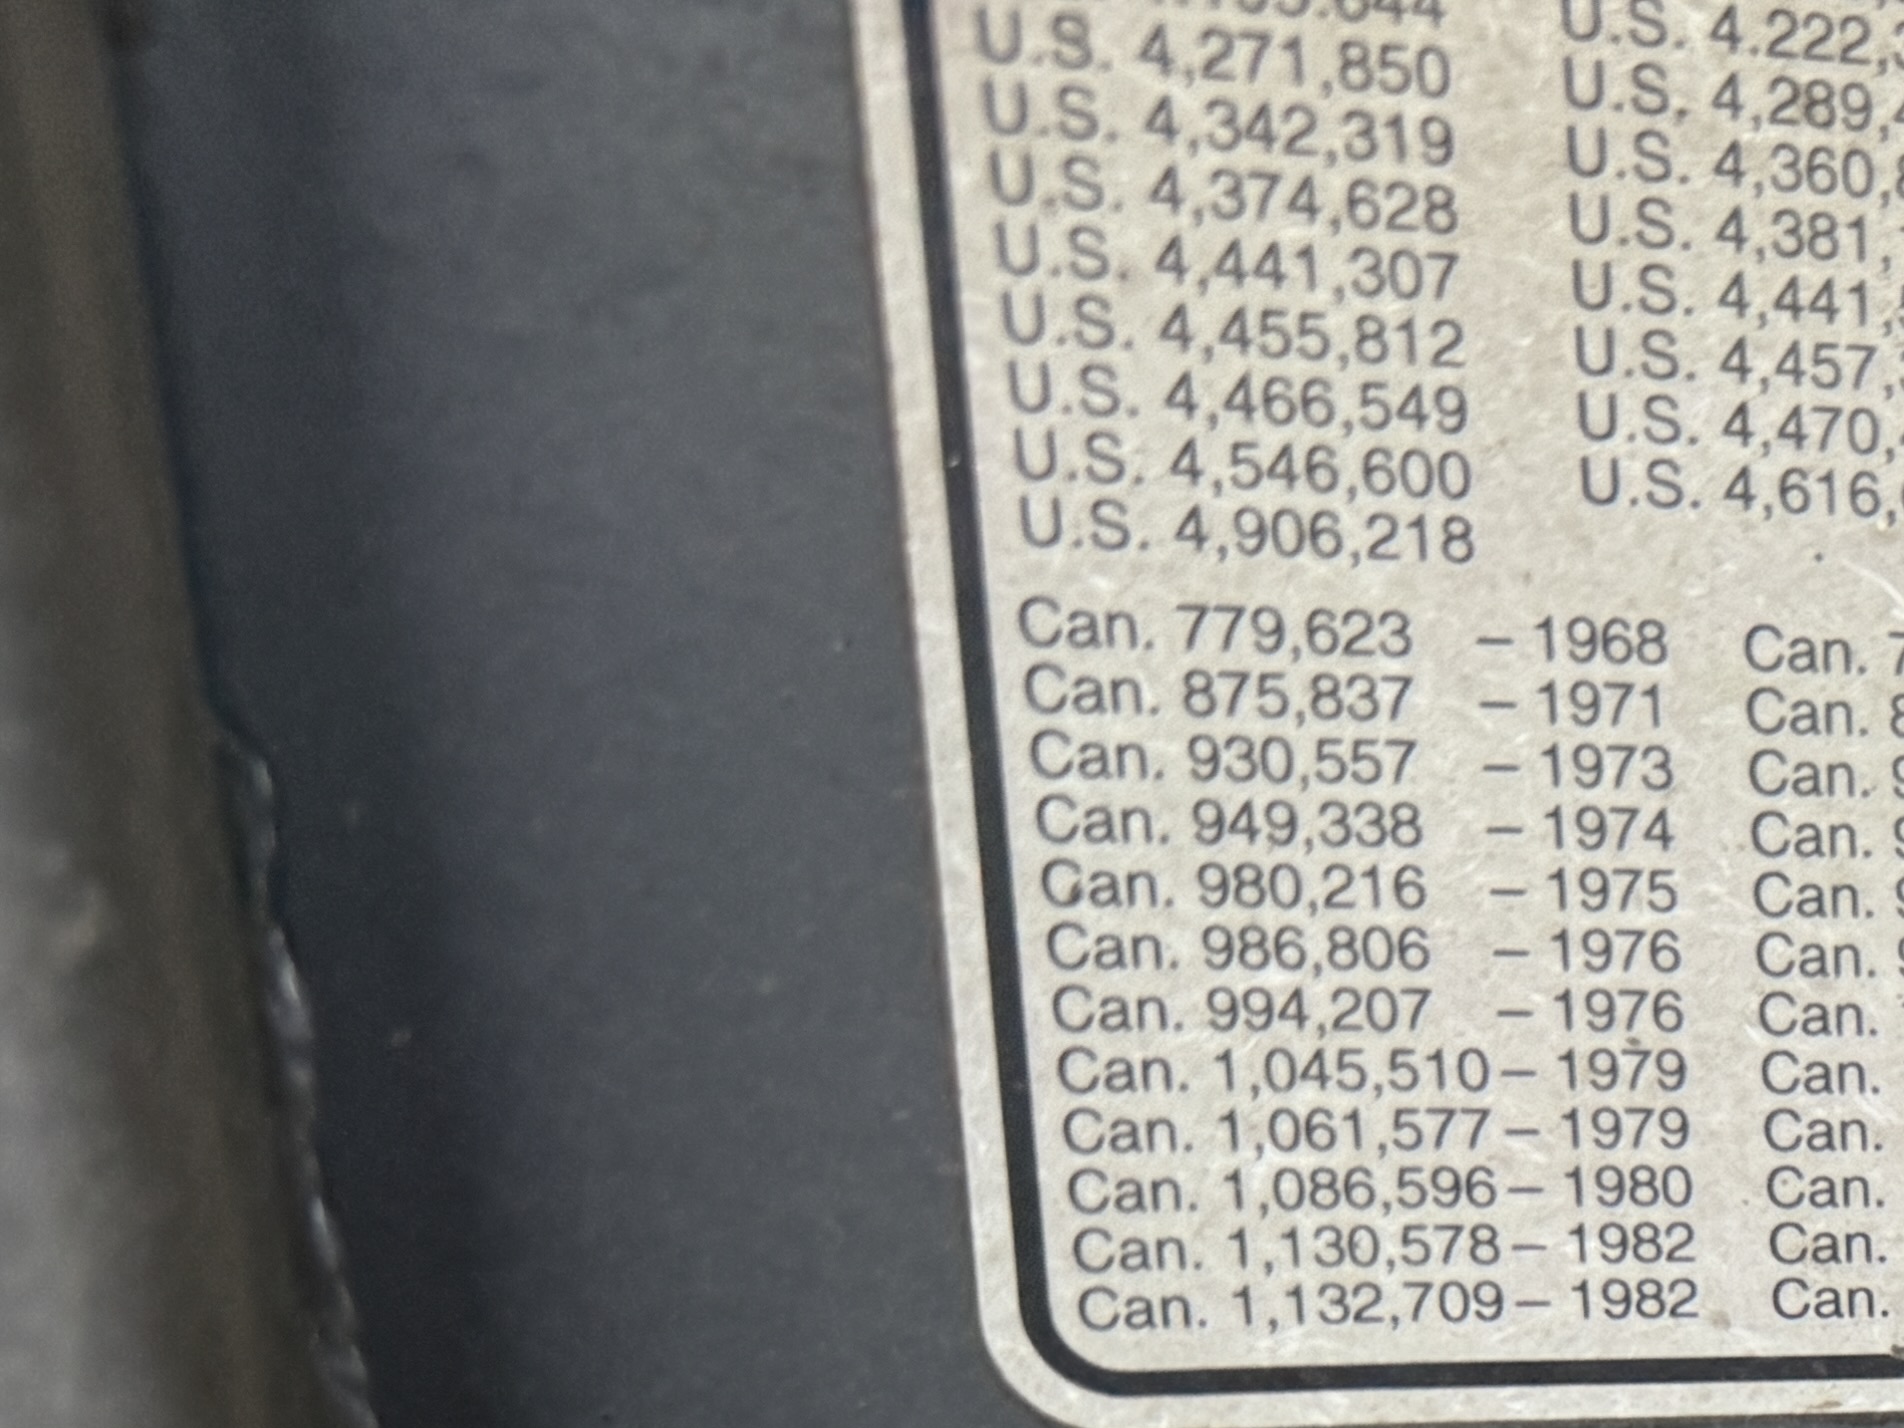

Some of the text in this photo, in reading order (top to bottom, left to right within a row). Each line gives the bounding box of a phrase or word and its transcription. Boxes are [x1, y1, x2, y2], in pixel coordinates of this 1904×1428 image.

[1560, 0, 1685, 48] U.S.
[976, 9, 1111, 69] U.S.
[1138, 24, 1450, 98] 4,271,850
[1563, 56, 1688, 122] U.S.
[982, 80, 1454, 166] U.S. 4,342,319
[1566, 125, 1689, 184] U.S.
[988, 150, 1457, 235] U.S. 4,374,628
[1569, 192, 1690, 250] U.S.
[994, 222, 1459, 303] U.S. 4,441,307
[1572, 259, 1693, 315] U.S.
[1001, 291, 1464, 369] U.S. 4,455,812
[1575, 325, 1695, 381] U.S.
[1007, 360, 1467, 436] U.S. 4,466,549
[1577, 391, 1698, 445] U.S.
[1014, 428, 1471, 502] U.S. 4,546,600
[1580, 456, 1700, 509] U.S.
[1019, 496, 1474, 567] U.S. 4,906,218
[1017, 595, 1412, 662] Can. 779,623
[1744, 623, 1866, 674] Can.
[1023, 662, 1413, 726] Can. 875,837
[1746, 686, 1868, 736] Can.
[1029, 728, 1417, 791] Can. 930,557
[1748, 748, 1869, 797] Can.
[1035, 793, 1423, 853] Can. 949,338
[1750, 810, 1871, 858] Can.
[1040, 858, 1426, 916] Can. 980,216
[1752, 870, 1873, 918] Can.
[1046, 921, 1430, 978] Can. 986,806
[1755, 931, 1876, 978] Can.
[1052, 984, 1431, 1039] Can. 994,207
[1758, 990, 1877, 1037] Can.
[1056, 1046, 1490, 1100] Can. 1,045,510
[1761, 1049, 1879, 1095] Can.
[1062, 1107, 1491, 1159] Can. 1,061,577
[1763, 1107, 1882, 1153] Can.
[1067, 1165, 1497, 1218] Can. 1,086,596
[1766, 1165, 1884, 1210] Can.
[1072, 1223, 1500, 1276] Can. 1,130,578
[1769, 1221, 1886, 1265] Can.
[1077, 1280, 1504, 1333] Can. 1,132,709
[1772, 1277, 1889, 1320] Can.
